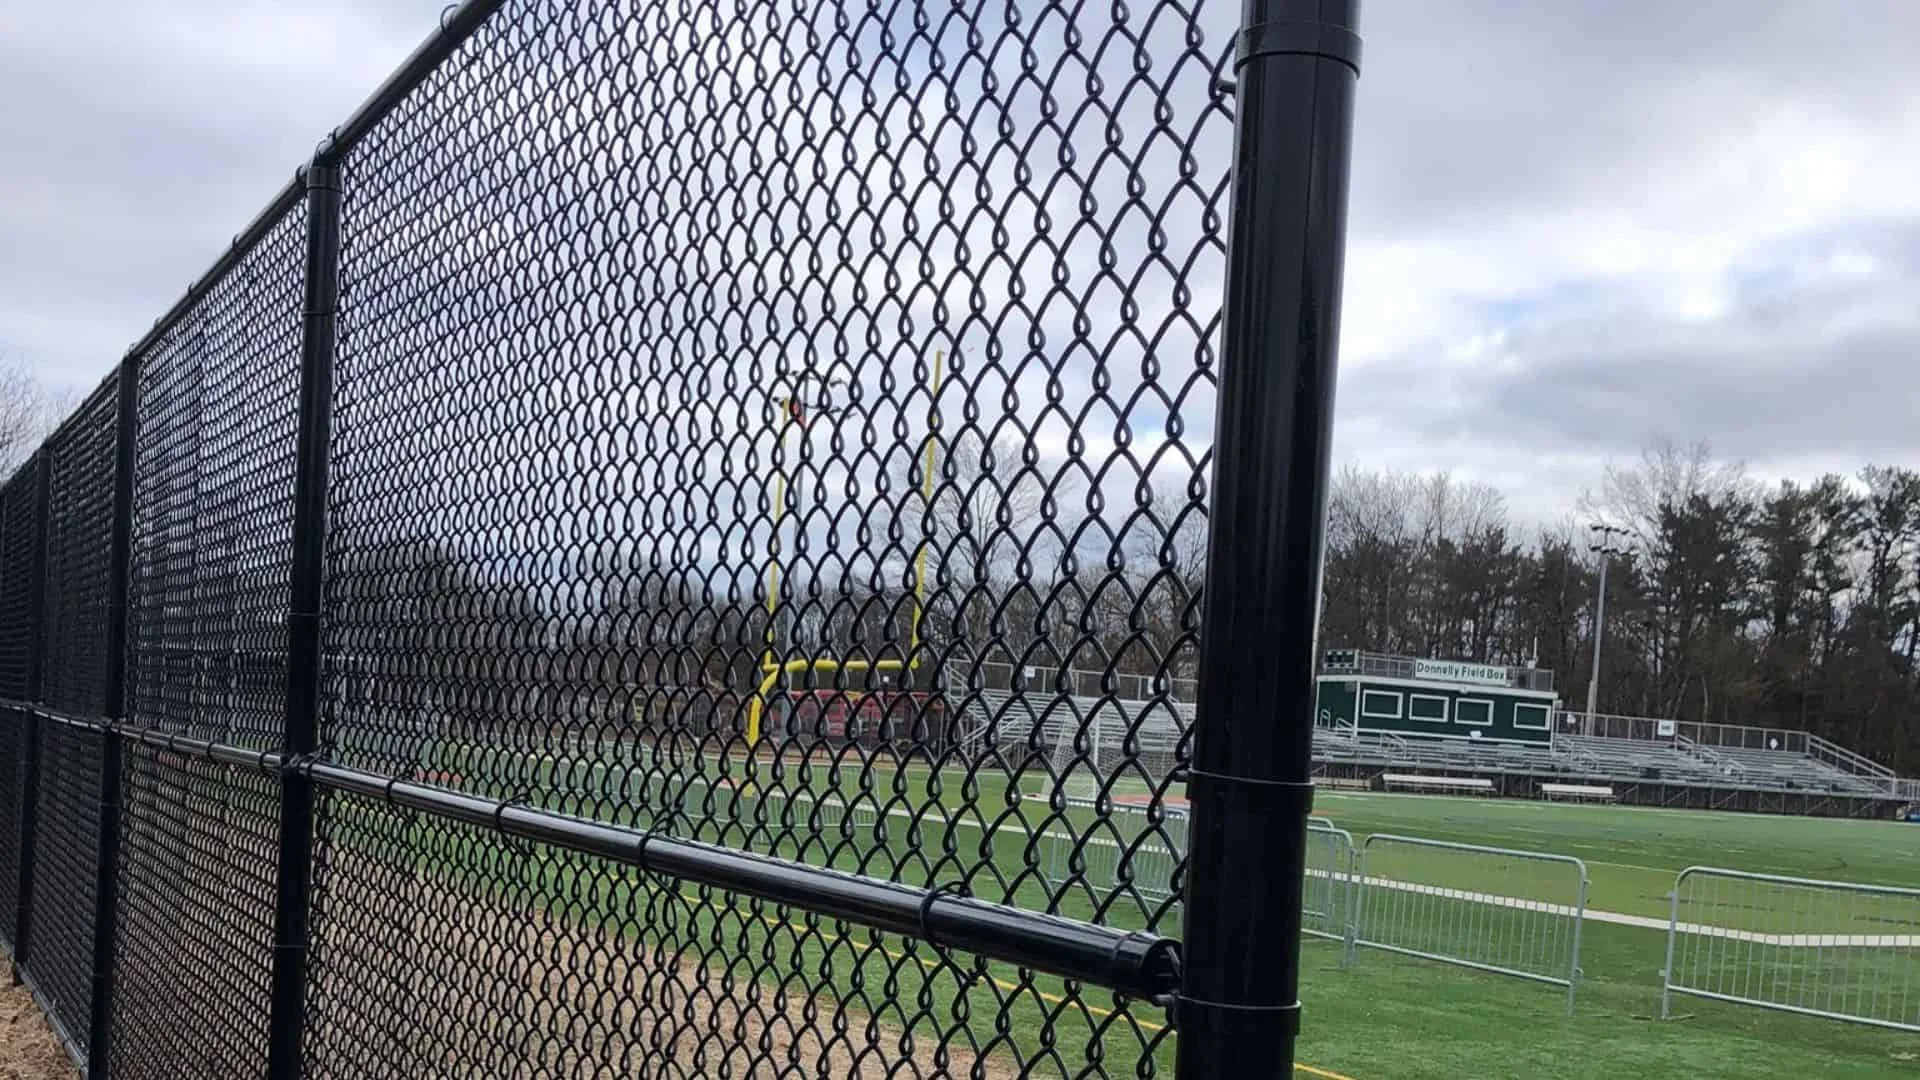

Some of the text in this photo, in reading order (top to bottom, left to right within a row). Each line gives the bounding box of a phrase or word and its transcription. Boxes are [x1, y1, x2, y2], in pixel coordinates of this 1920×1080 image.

[1417, 662, 1505, 679] Donnelly Field Box
